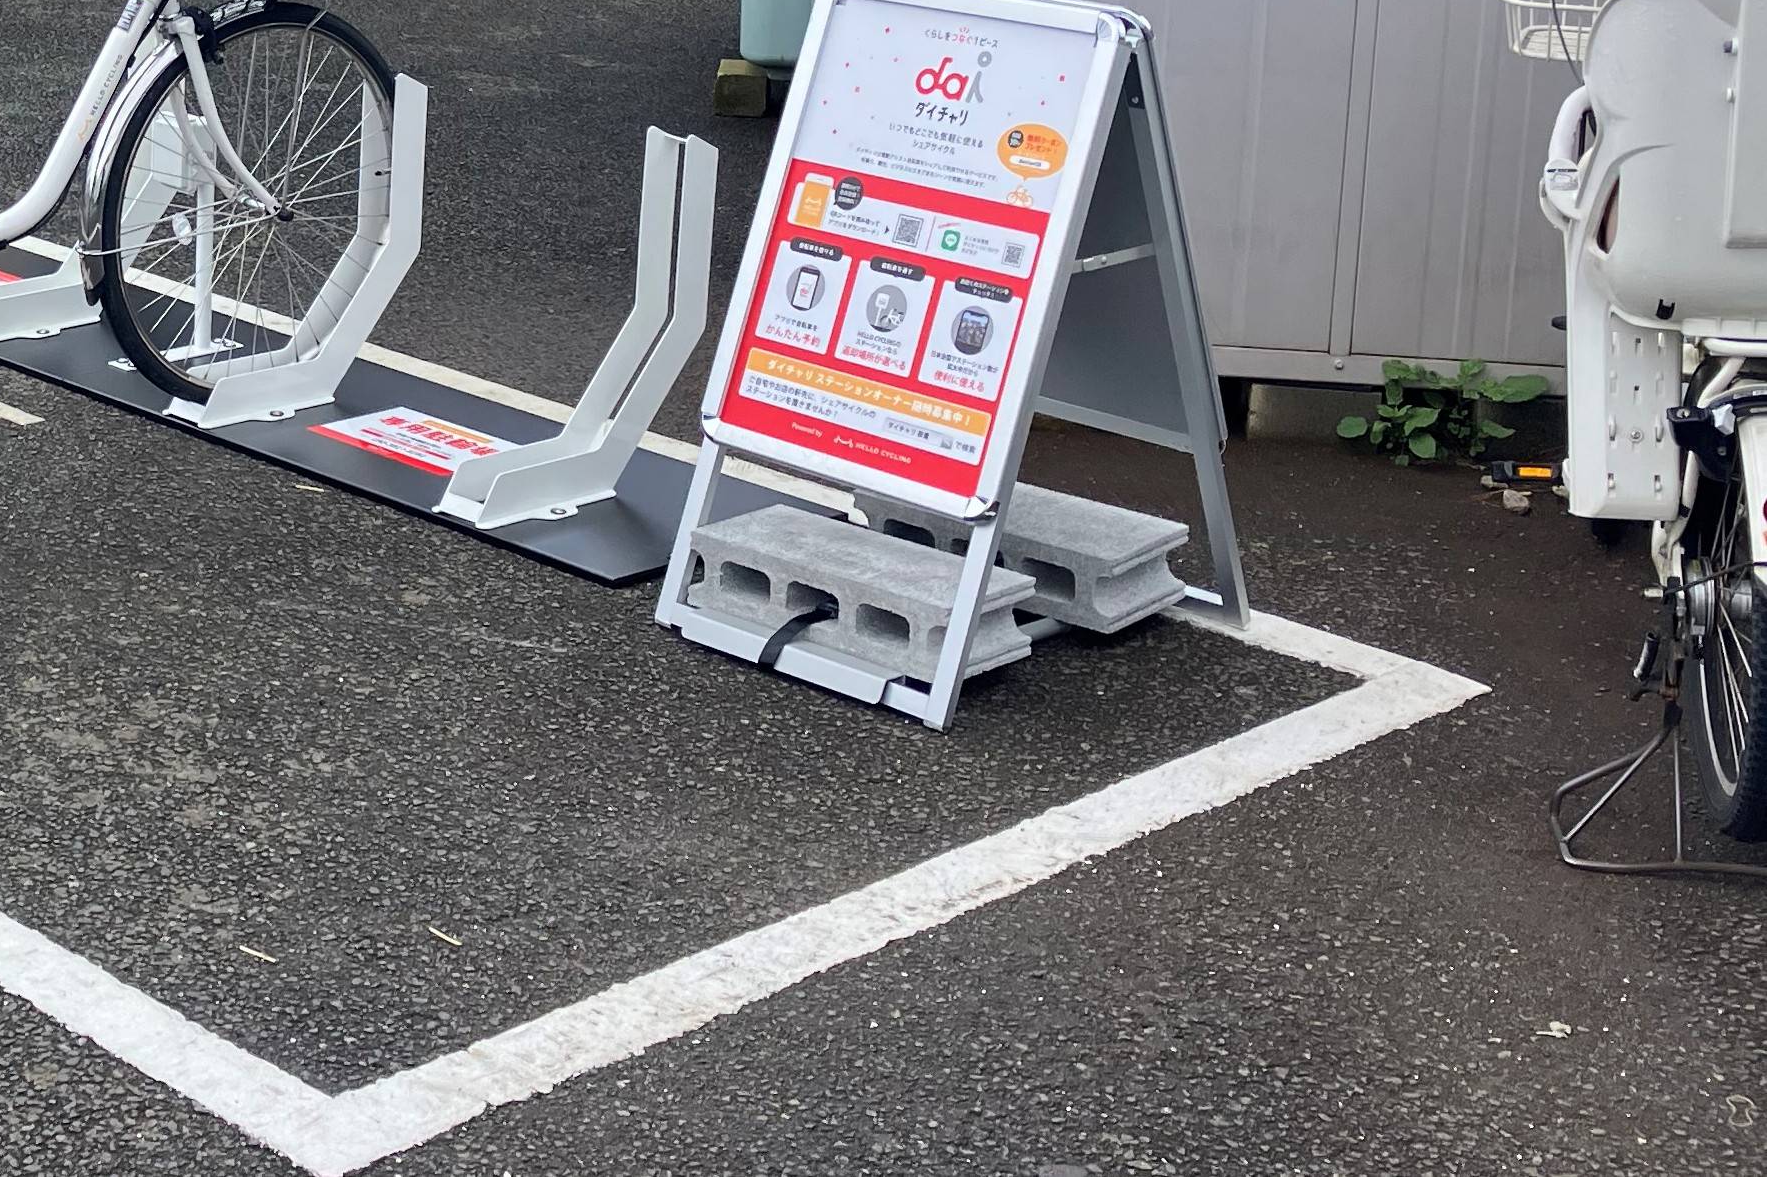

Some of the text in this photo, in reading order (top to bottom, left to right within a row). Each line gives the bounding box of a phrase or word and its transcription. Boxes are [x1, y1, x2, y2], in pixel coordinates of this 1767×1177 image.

[914, 101, 969, 127] ダイチャリ
[855, 442, 880, 455] HELLO
